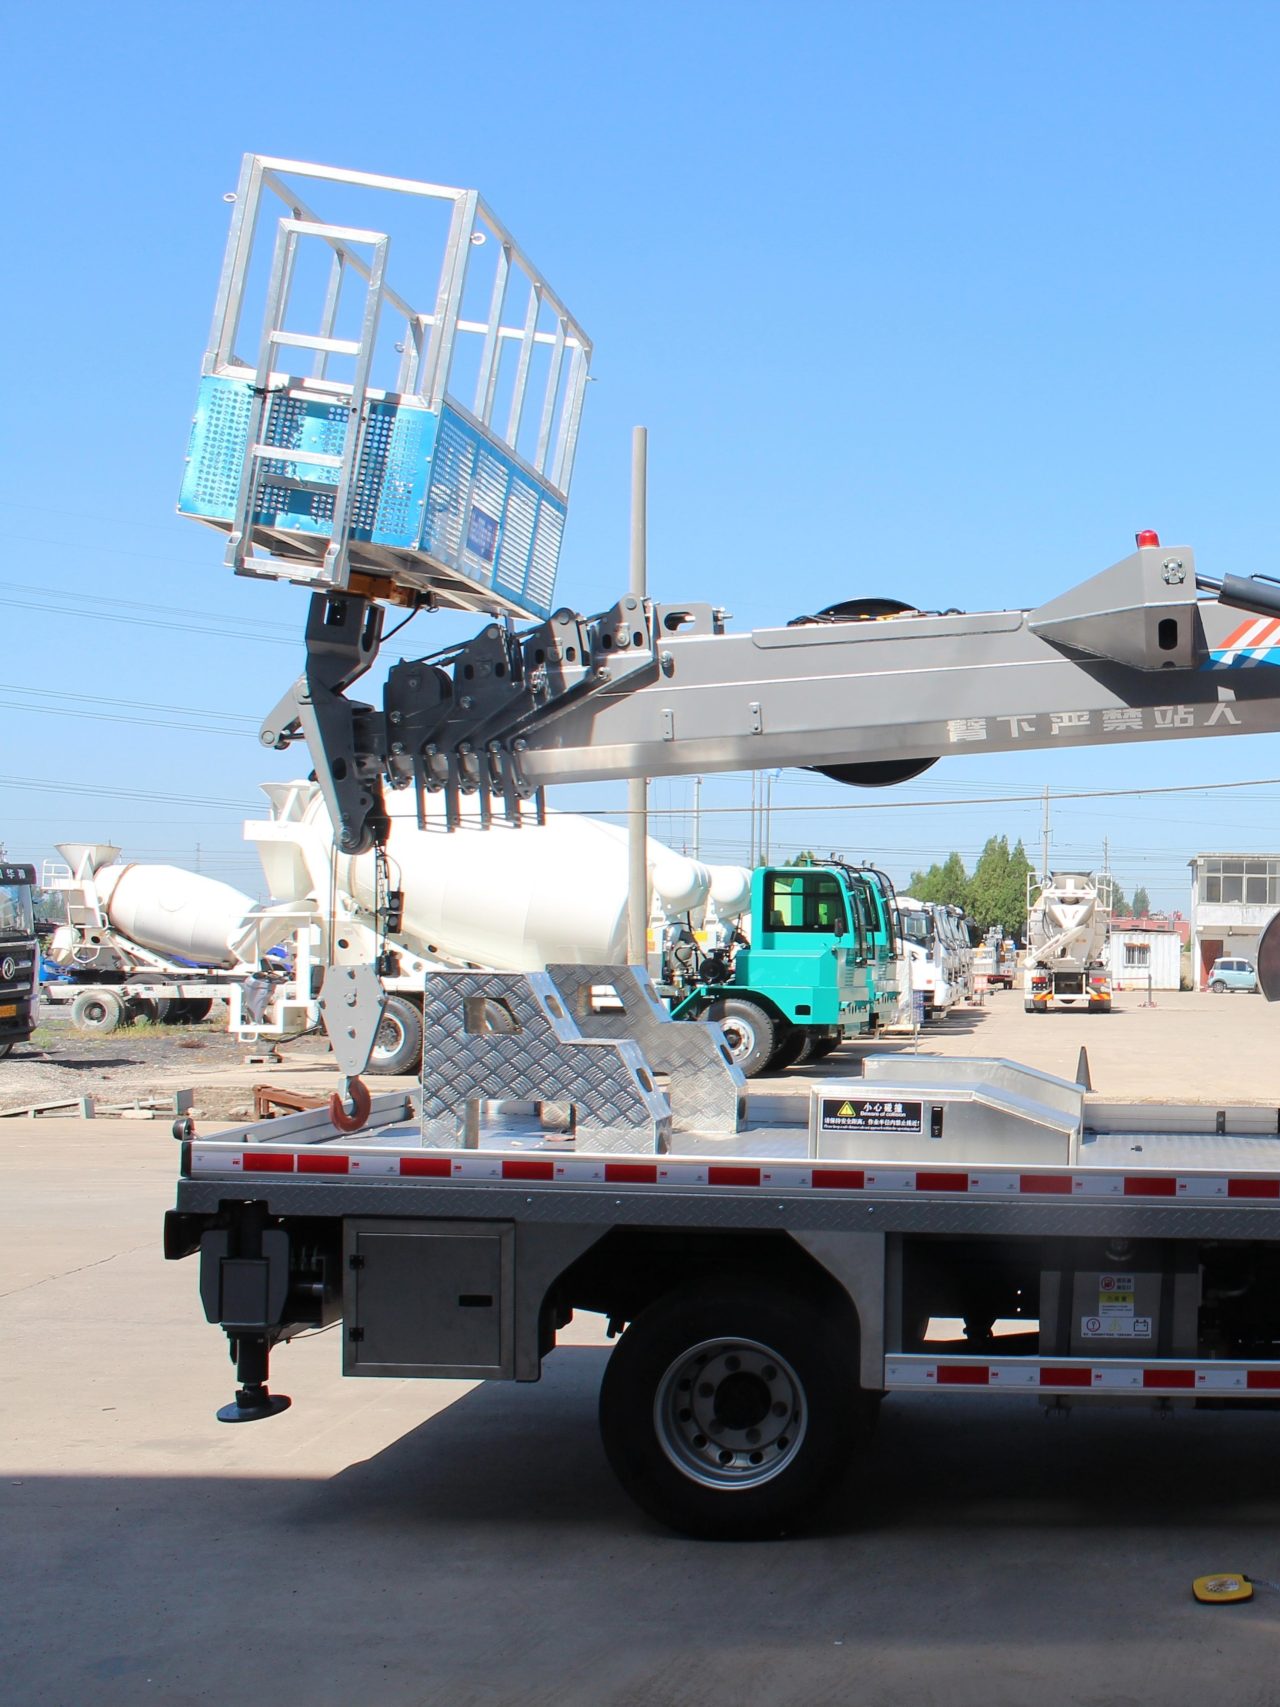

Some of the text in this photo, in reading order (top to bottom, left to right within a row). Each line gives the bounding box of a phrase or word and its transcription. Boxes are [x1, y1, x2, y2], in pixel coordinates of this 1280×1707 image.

[946, 686, 1242, 743] 臂下严禁站人
